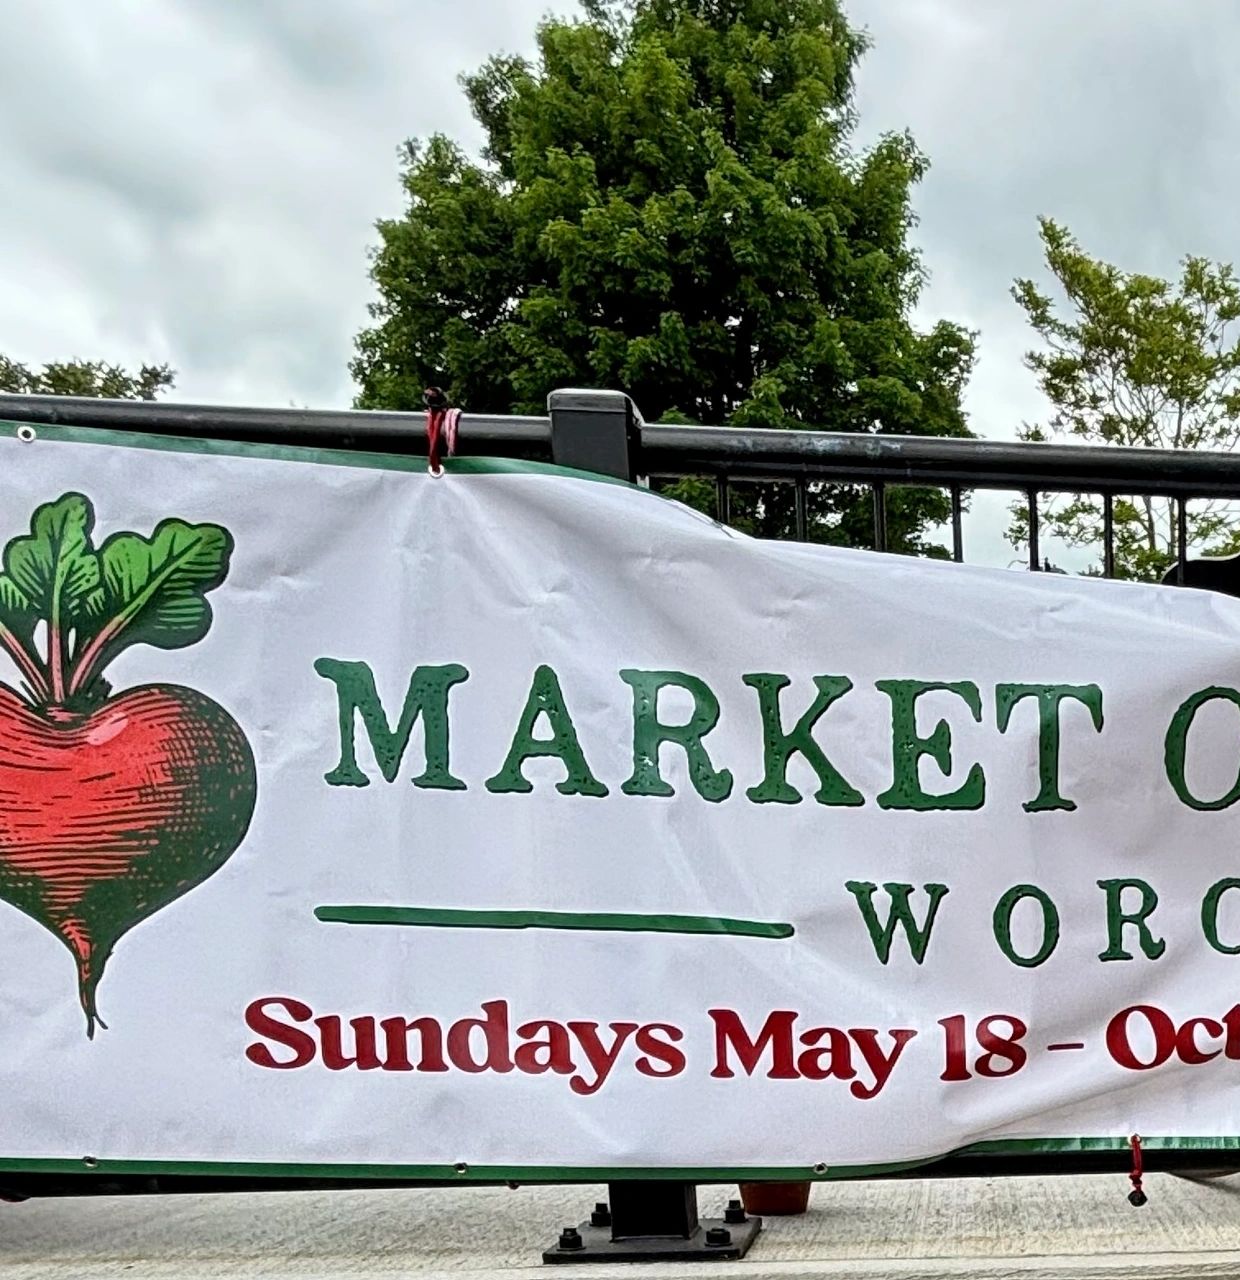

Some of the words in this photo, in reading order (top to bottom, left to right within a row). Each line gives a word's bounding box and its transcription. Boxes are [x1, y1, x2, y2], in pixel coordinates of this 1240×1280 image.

[313, 656, 1104, 811] MARKET
[245, 996, 686, 1095] Sundays
[709, 1006, 918, 1101] May
[937, 1014, 1028, 1083] 18
